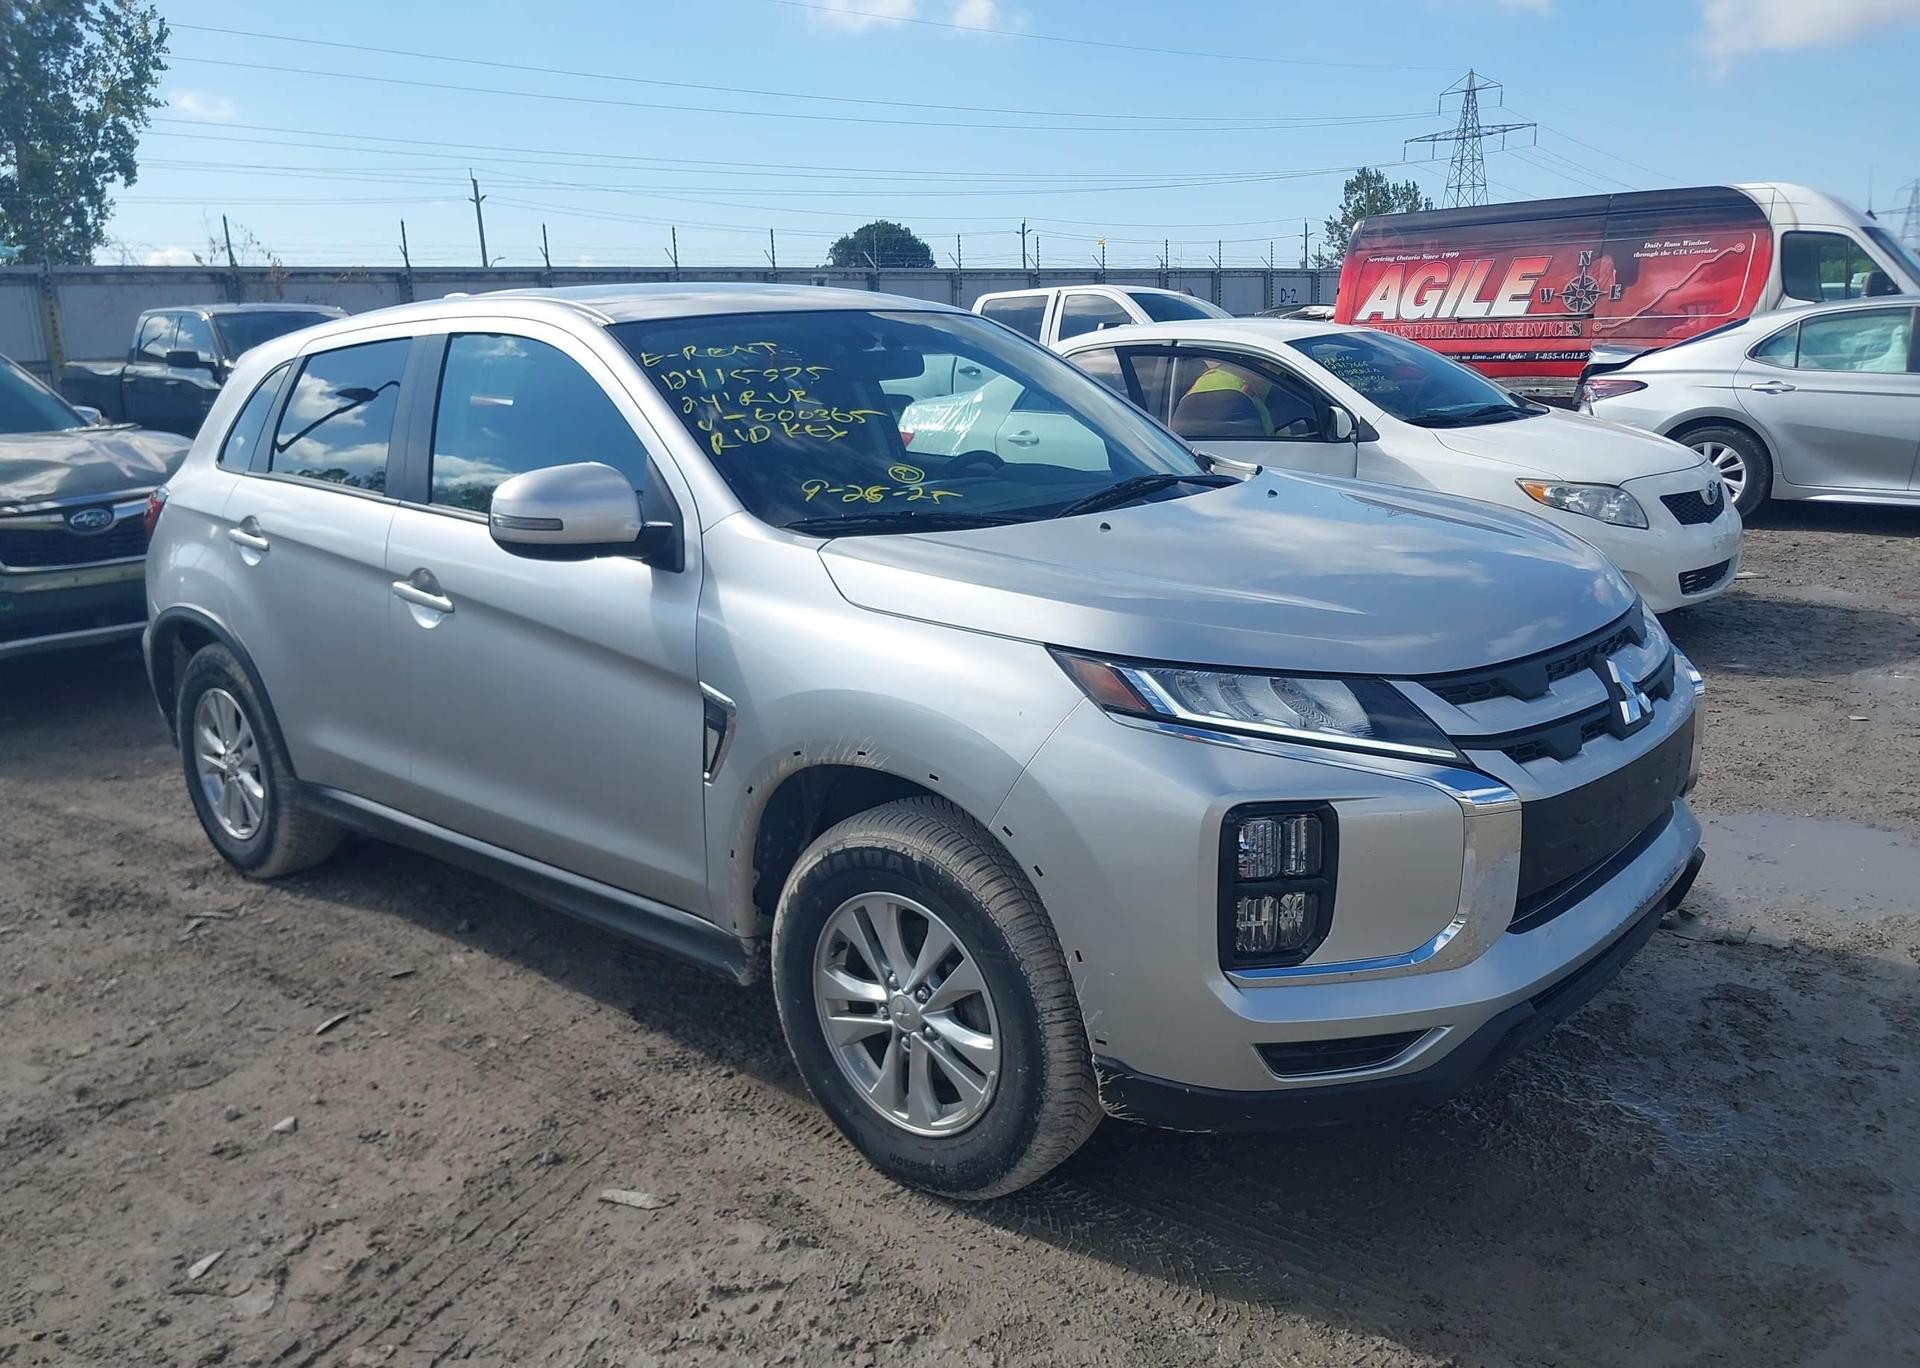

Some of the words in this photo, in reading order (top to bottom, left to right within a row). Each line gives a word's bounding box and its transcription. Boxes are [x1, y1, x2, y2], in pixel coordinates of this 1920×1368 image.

[1633, 249, 1659, 258] through
[1689, 247, 1719, 255] Corridor
[1643, 241, 1662, 249] Daily
[1441, 251, 1460, 259] 1999
[1578, 250, 1593, 266] N
[1351, 255, 1553, 323] AGILE
[1539, 287, 1555, 303] W
[1608, 283, 1622, 300] E
[1502, 321, 1582, 338] SERVICES
[1506, 352, 1527, 361] Agile!
[1535, 351, 1593, 360] 1-855-AGILE-
